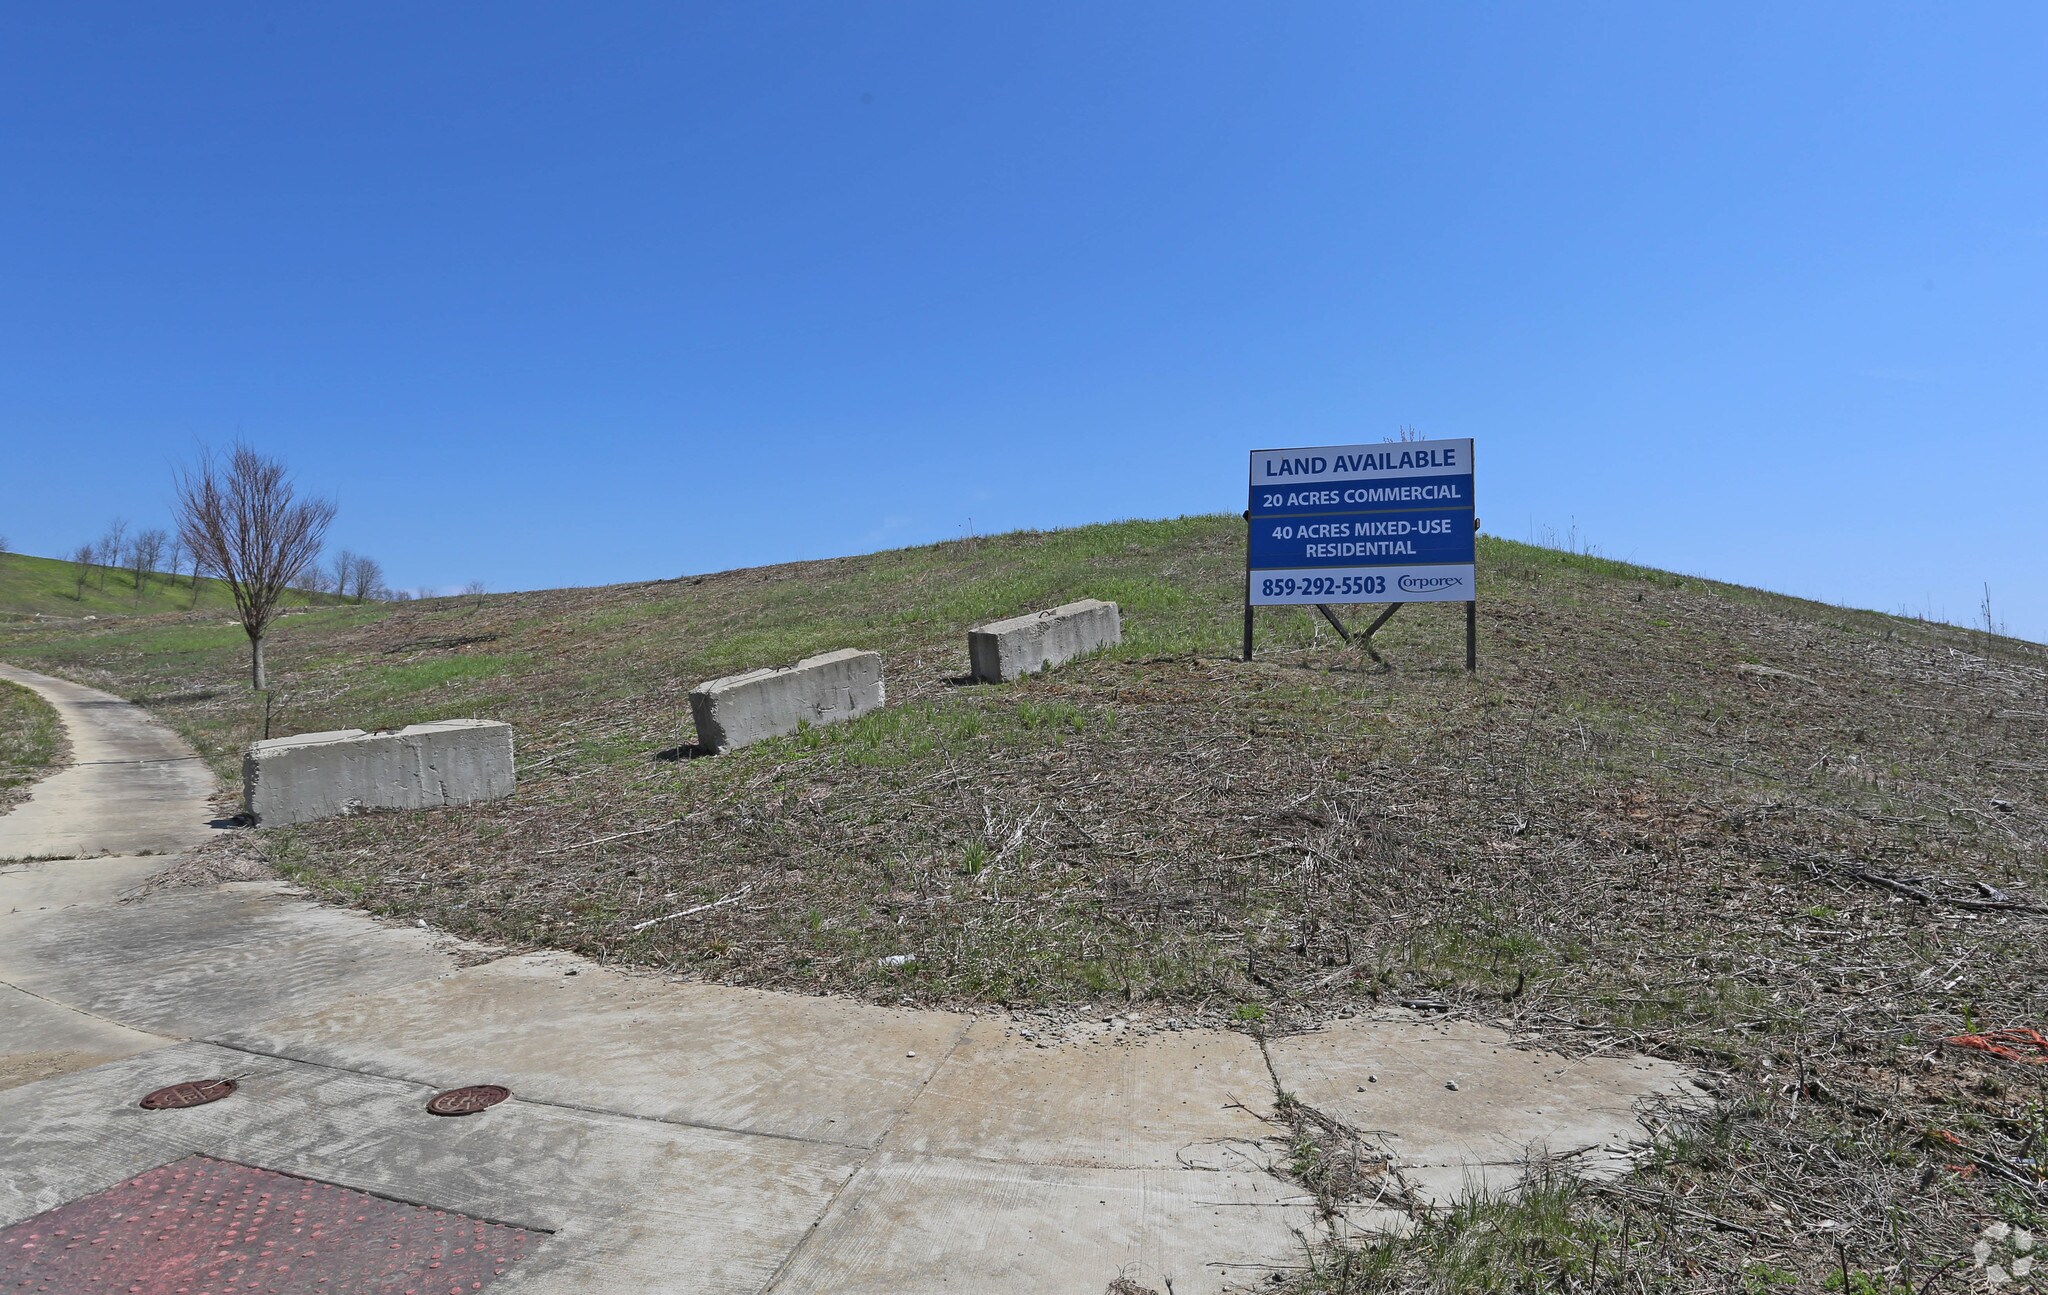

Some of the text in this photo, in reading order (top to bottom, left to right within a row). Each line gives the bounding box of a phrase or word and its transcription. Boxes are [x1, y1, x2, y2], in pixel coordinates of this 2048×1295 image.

[1266, 449, 1456, 477] LAND AVAILABLE
[1263, 485, 1461, 507] 20 ACRES COMMERCIAL
[1272, 520, 1451, 539] 40 ACRES MIXED-USE
[1306, 541, 1416, 558] RESIDENTIAL
[1262, 576, 1386, 596] 859-292-5503
[1398, 575, 1463, 593] Corporex
